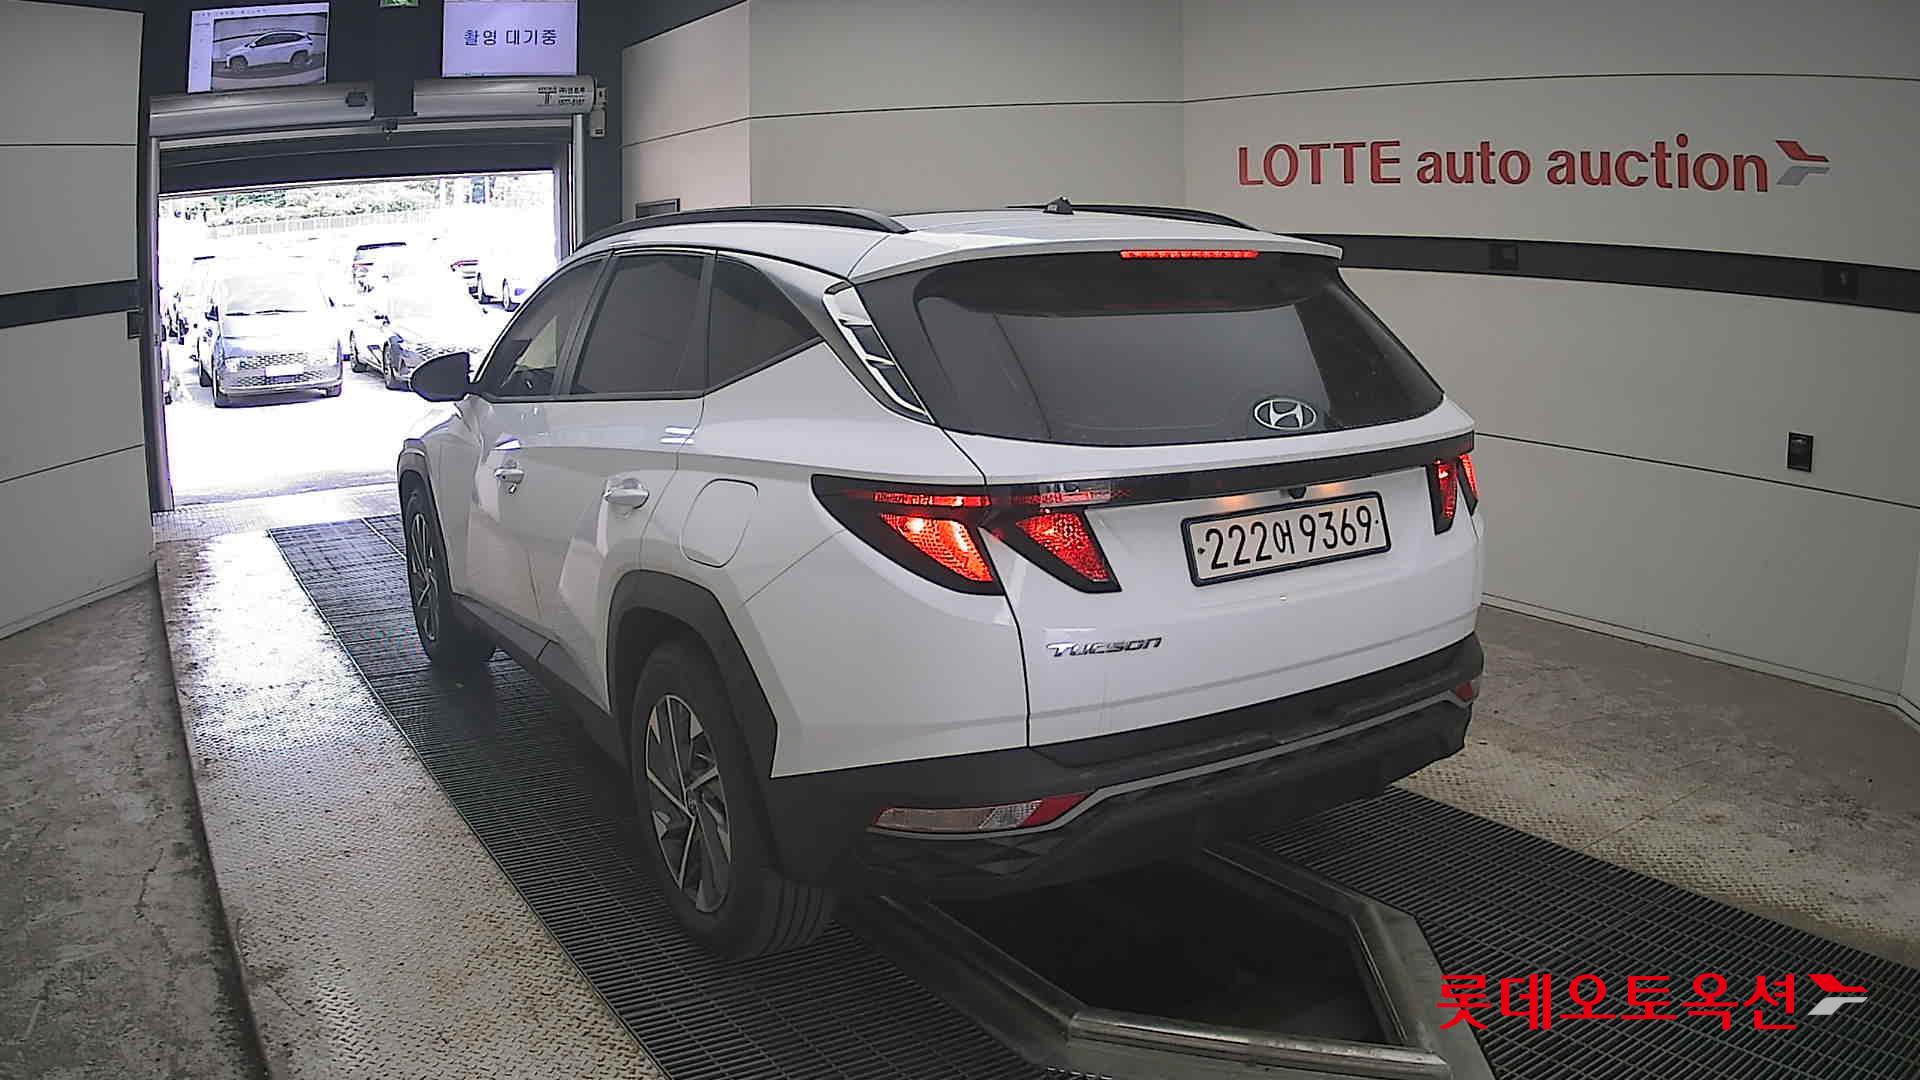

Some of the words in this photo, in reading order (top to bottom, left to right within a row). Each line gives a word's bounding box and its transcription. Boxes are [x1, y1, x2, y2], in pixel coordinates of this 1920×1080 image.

[464, 28, 497, 47] 촬영
[505, 28, 558, 46] 대기중
[1237, 139, 1401, 187] LOTTE
[1416, 140, 1532, 185] auto
[1545, 132, 1768, 193] auction
[1046, 636, 1163, 657] TUCSON
